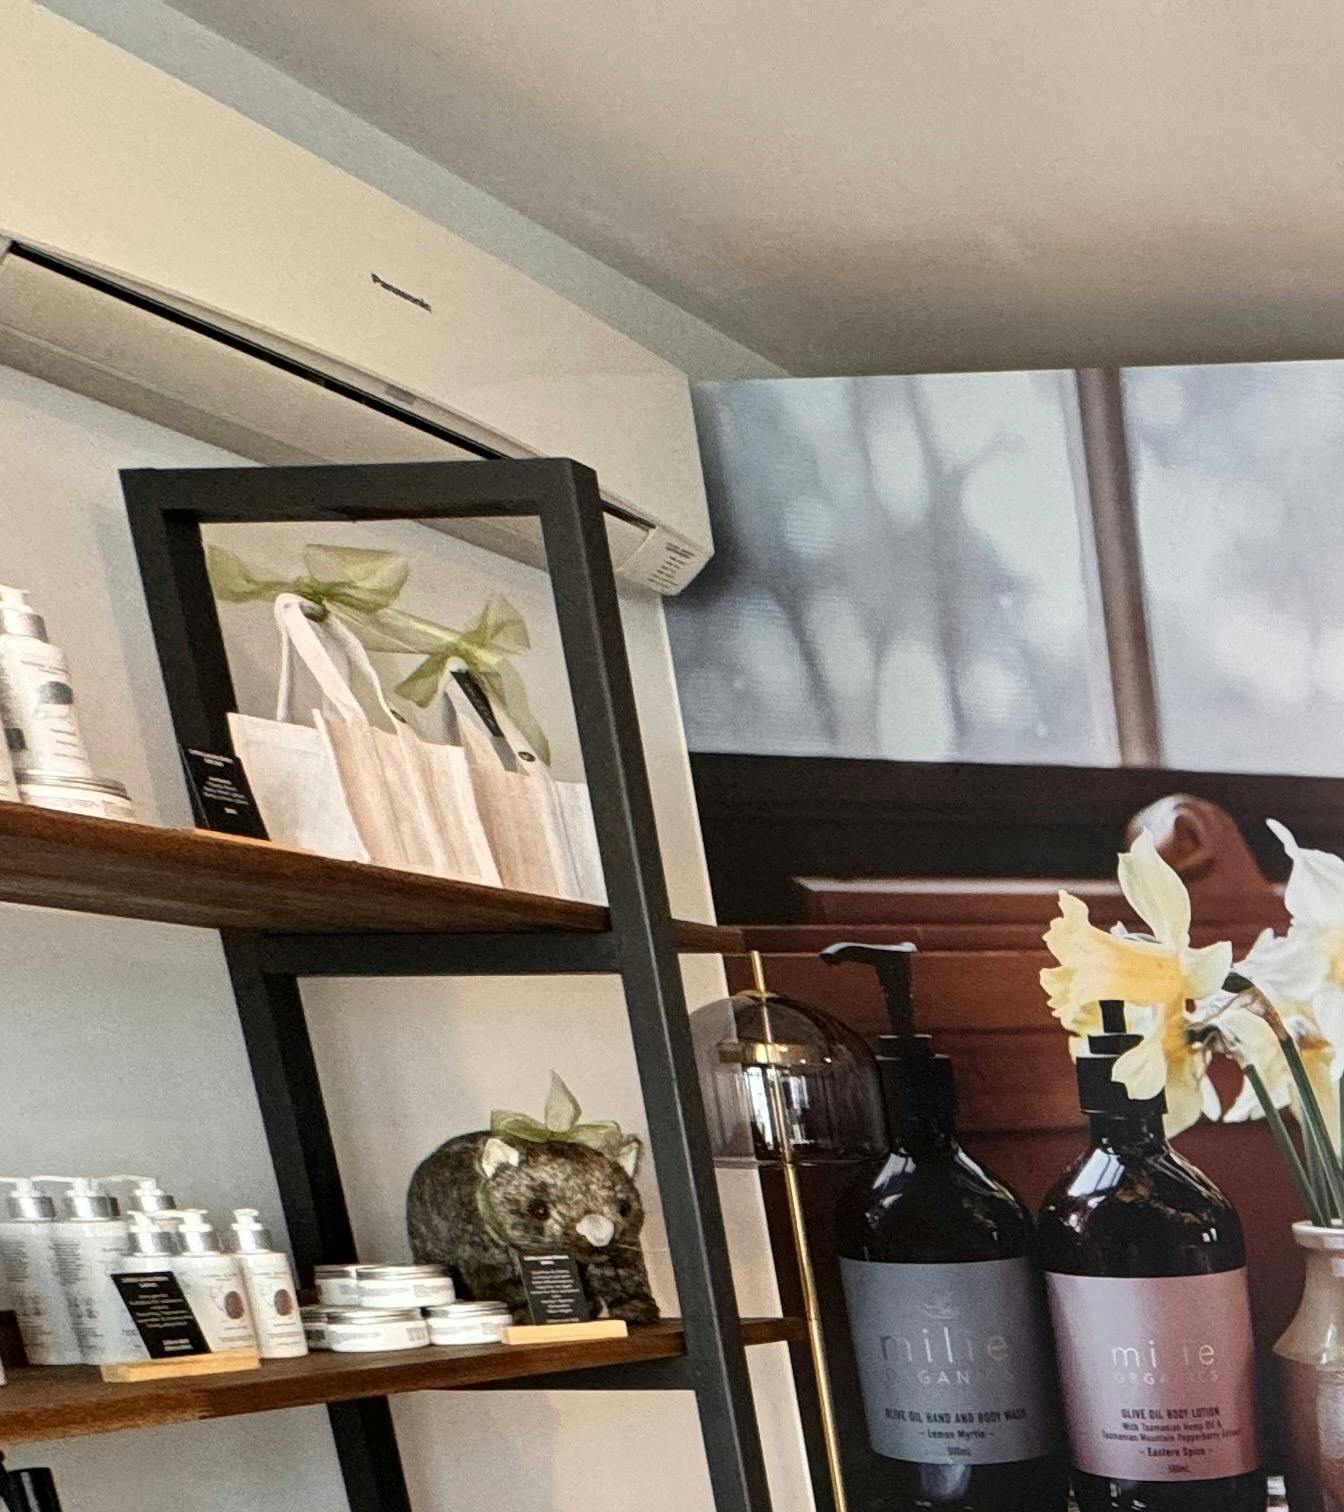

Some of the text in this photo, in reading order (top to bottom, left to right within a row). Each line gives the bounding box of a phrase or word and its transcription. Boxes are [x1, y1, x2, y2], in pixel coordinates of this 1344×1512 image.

[1111, 1339, 1216, 1369] miie
[926, 1412, 951, 1424] HAND
[955, 1412, 974, 1424] AND
[978, 1410, 1003, 1424] BODY
[1121, 1408, 1146, 1420] OLIVE
[1148, 1408, 1164, 1420] OIL
[1191, 1407, 1220, 1419] LOTION
